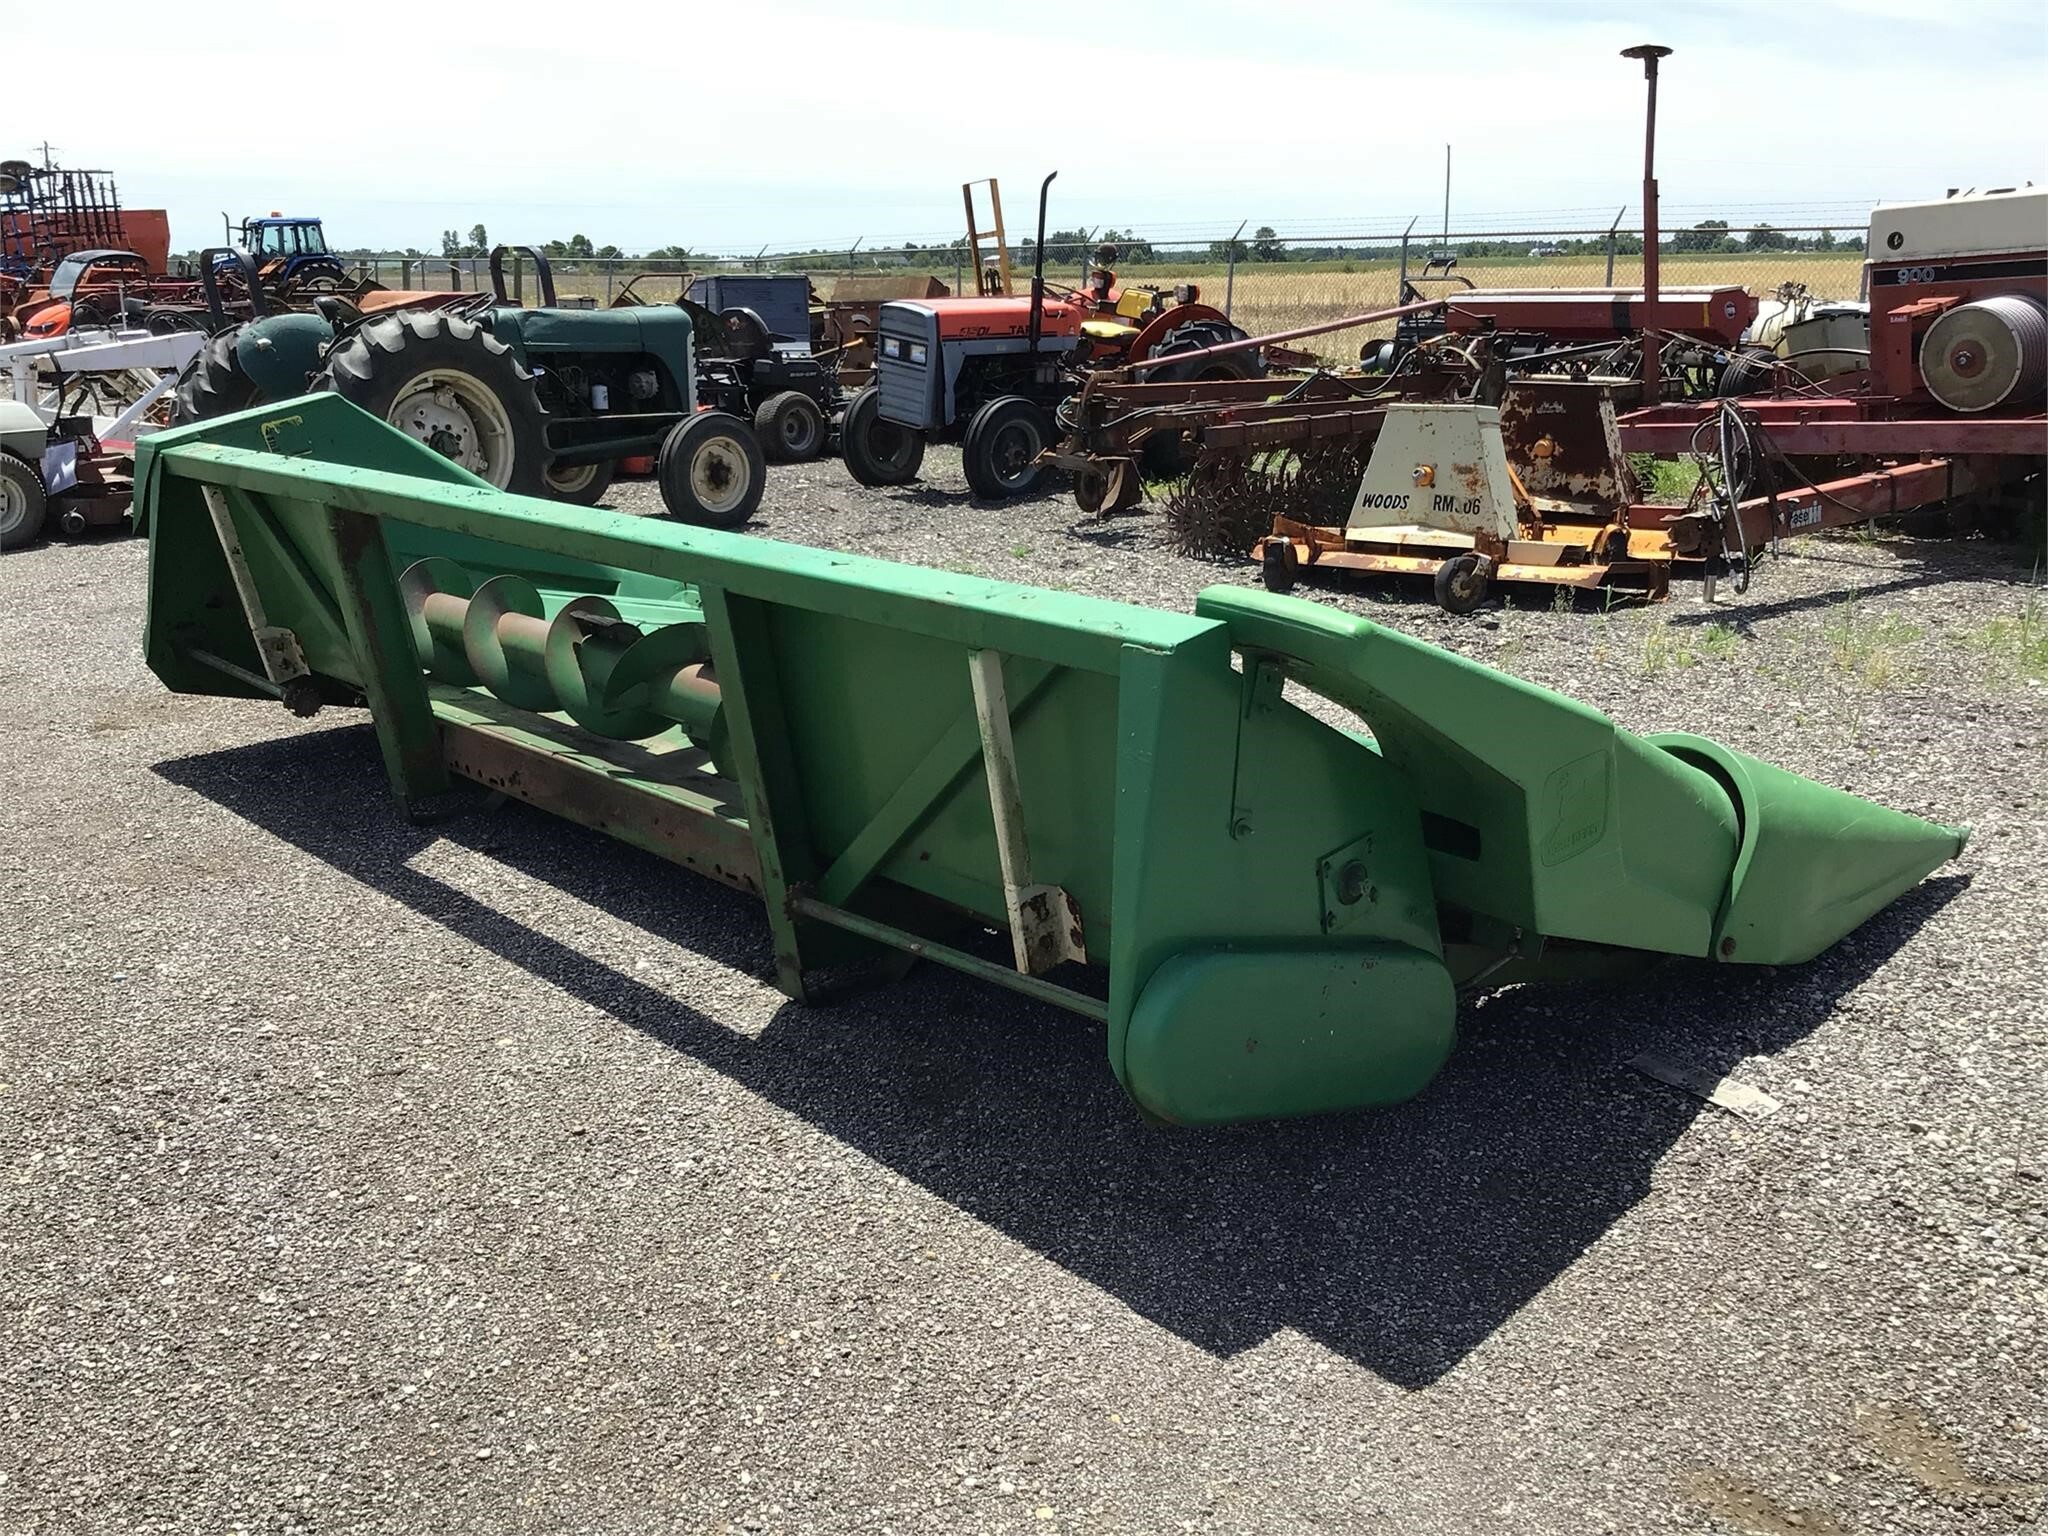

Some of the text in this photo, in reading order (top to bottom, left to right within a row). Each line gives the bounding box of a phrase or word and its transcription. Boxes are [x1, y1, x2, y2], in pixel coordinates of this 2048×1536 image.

[1897, 267, 1935, 285] 900
[1362, 493, 1481, 516] WOODS RM06
